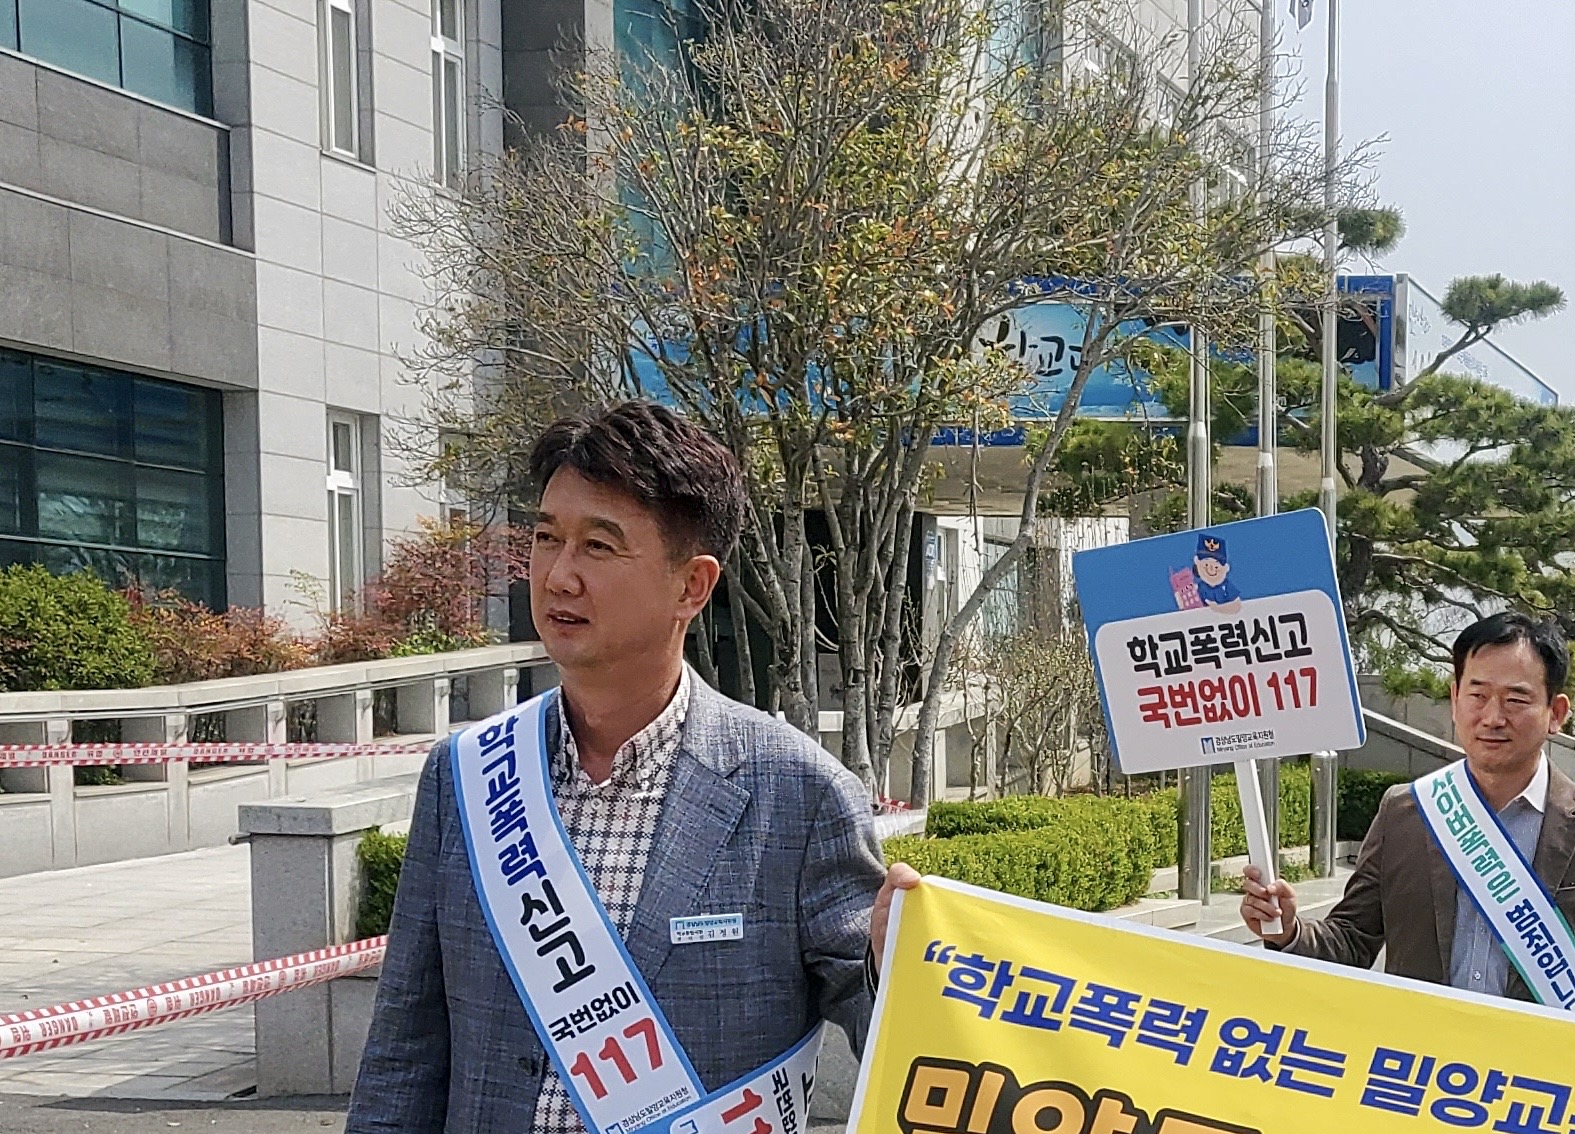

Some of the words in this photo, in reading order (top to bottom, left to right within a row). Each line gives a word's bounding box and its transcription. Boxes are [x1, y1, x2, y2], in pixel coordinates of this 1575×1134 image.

[1126, 612, 1313, 678] 학교폭력신고
[1137, 672, 1262, 728] 국번없이
[1267, 667, 1317, 710] 117
[477, 715, 547, 886] 학교폭력
[520, 879, 596, 993] 신고
[549, 981, 640, 1042] 국번없이
[570, 1017, 664, 1100] 117
[1209, 1017, 1347, 1100] 없는
